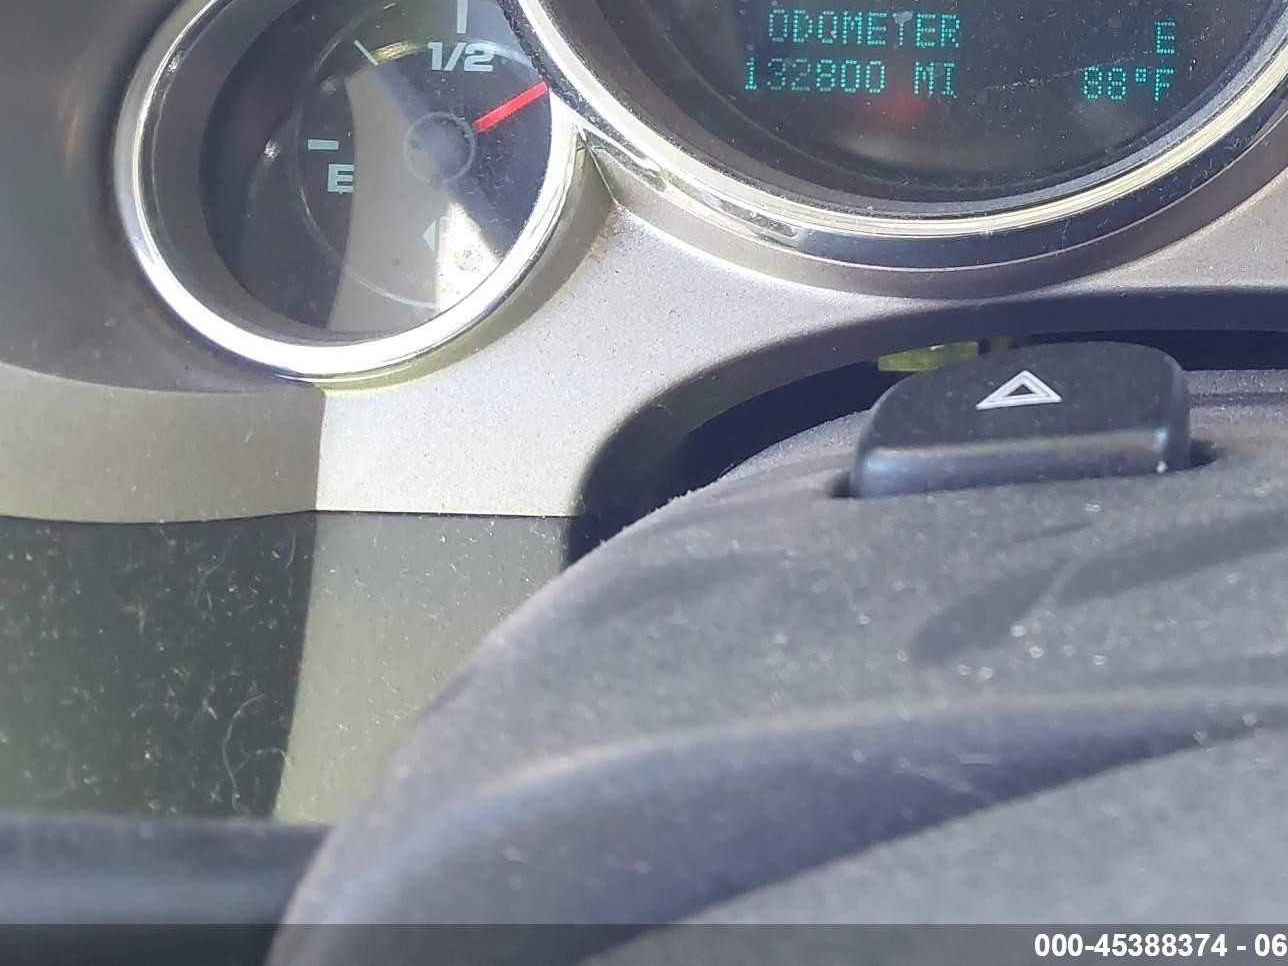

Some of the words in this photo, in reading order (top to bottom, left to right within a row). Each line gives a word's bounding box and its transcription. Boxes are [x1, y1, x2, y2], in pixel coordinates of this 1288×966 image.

[768, 9, 960, 48] ODOMETER
[1155, 21, 1176, 54] E
[429, 41, 494, 73] 1/2
[745, 57, 886, 94] 132800
[913, 61, 958, 97] MI
[327, 164, 354, 193] E
